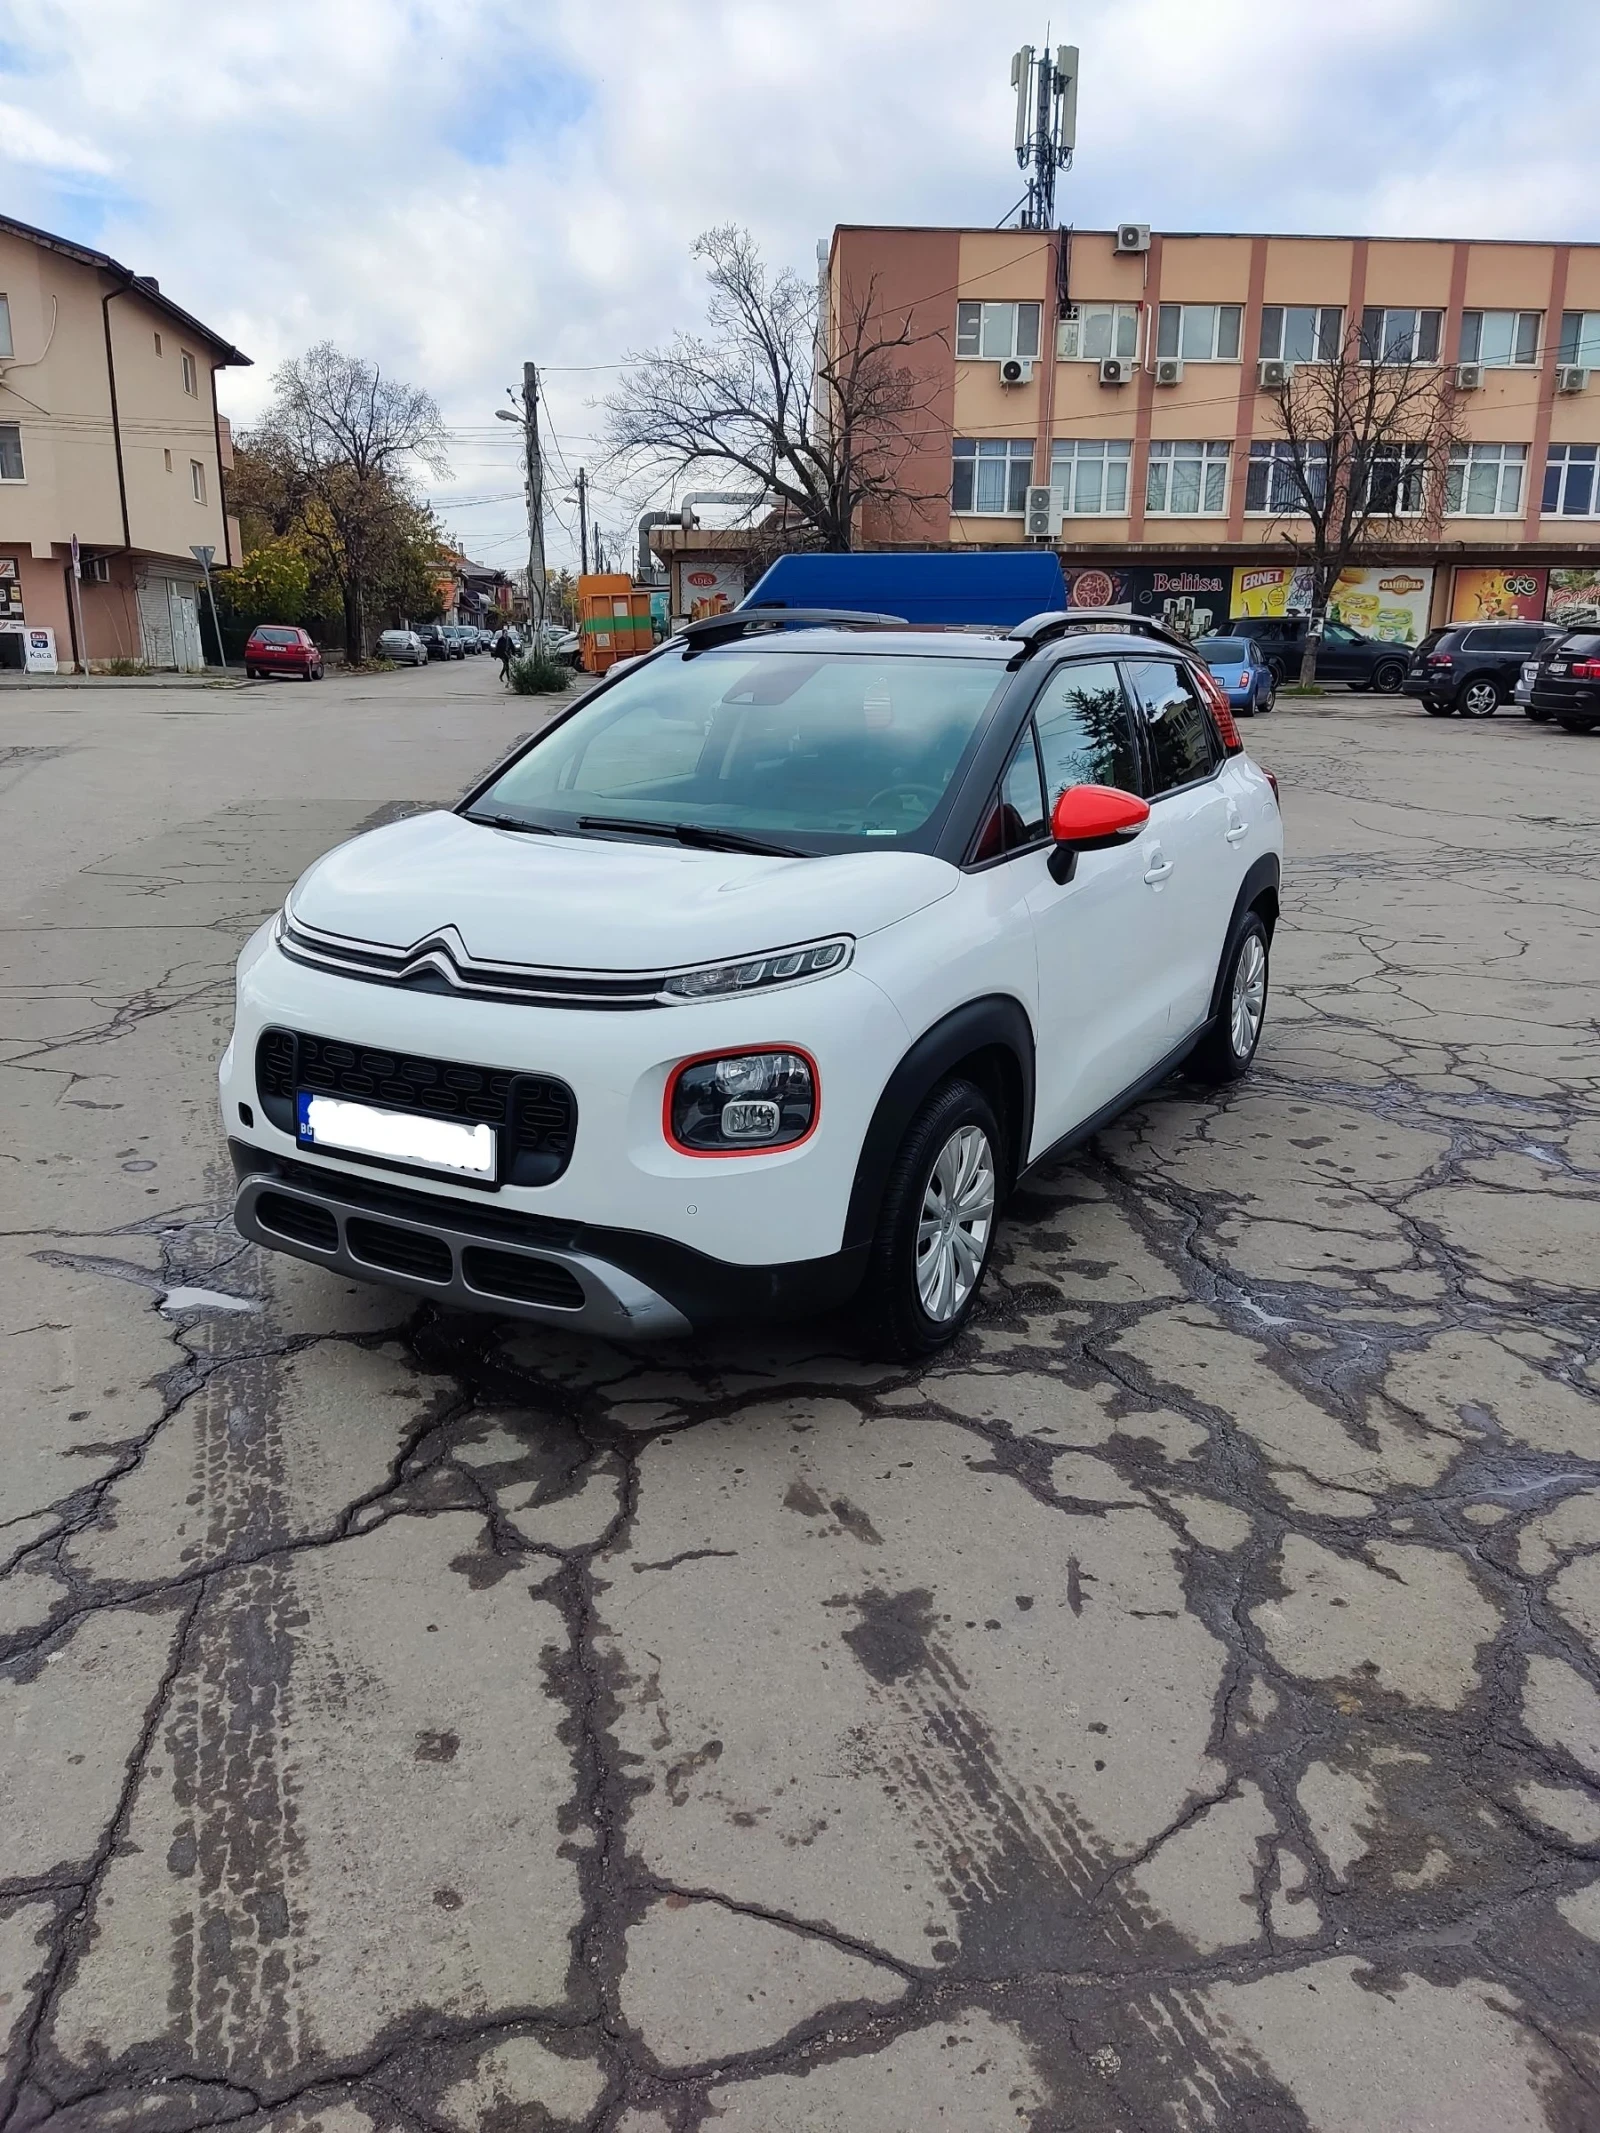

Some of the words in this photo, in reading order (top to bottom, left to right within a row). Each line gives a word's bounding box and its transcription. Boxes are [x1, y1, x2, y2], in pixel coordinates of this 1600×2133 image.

[692, 577, 713, 585] ADES
[1152, 572, 1223, 592] Beliisa
[301, 1122, 313, 1136] BG
